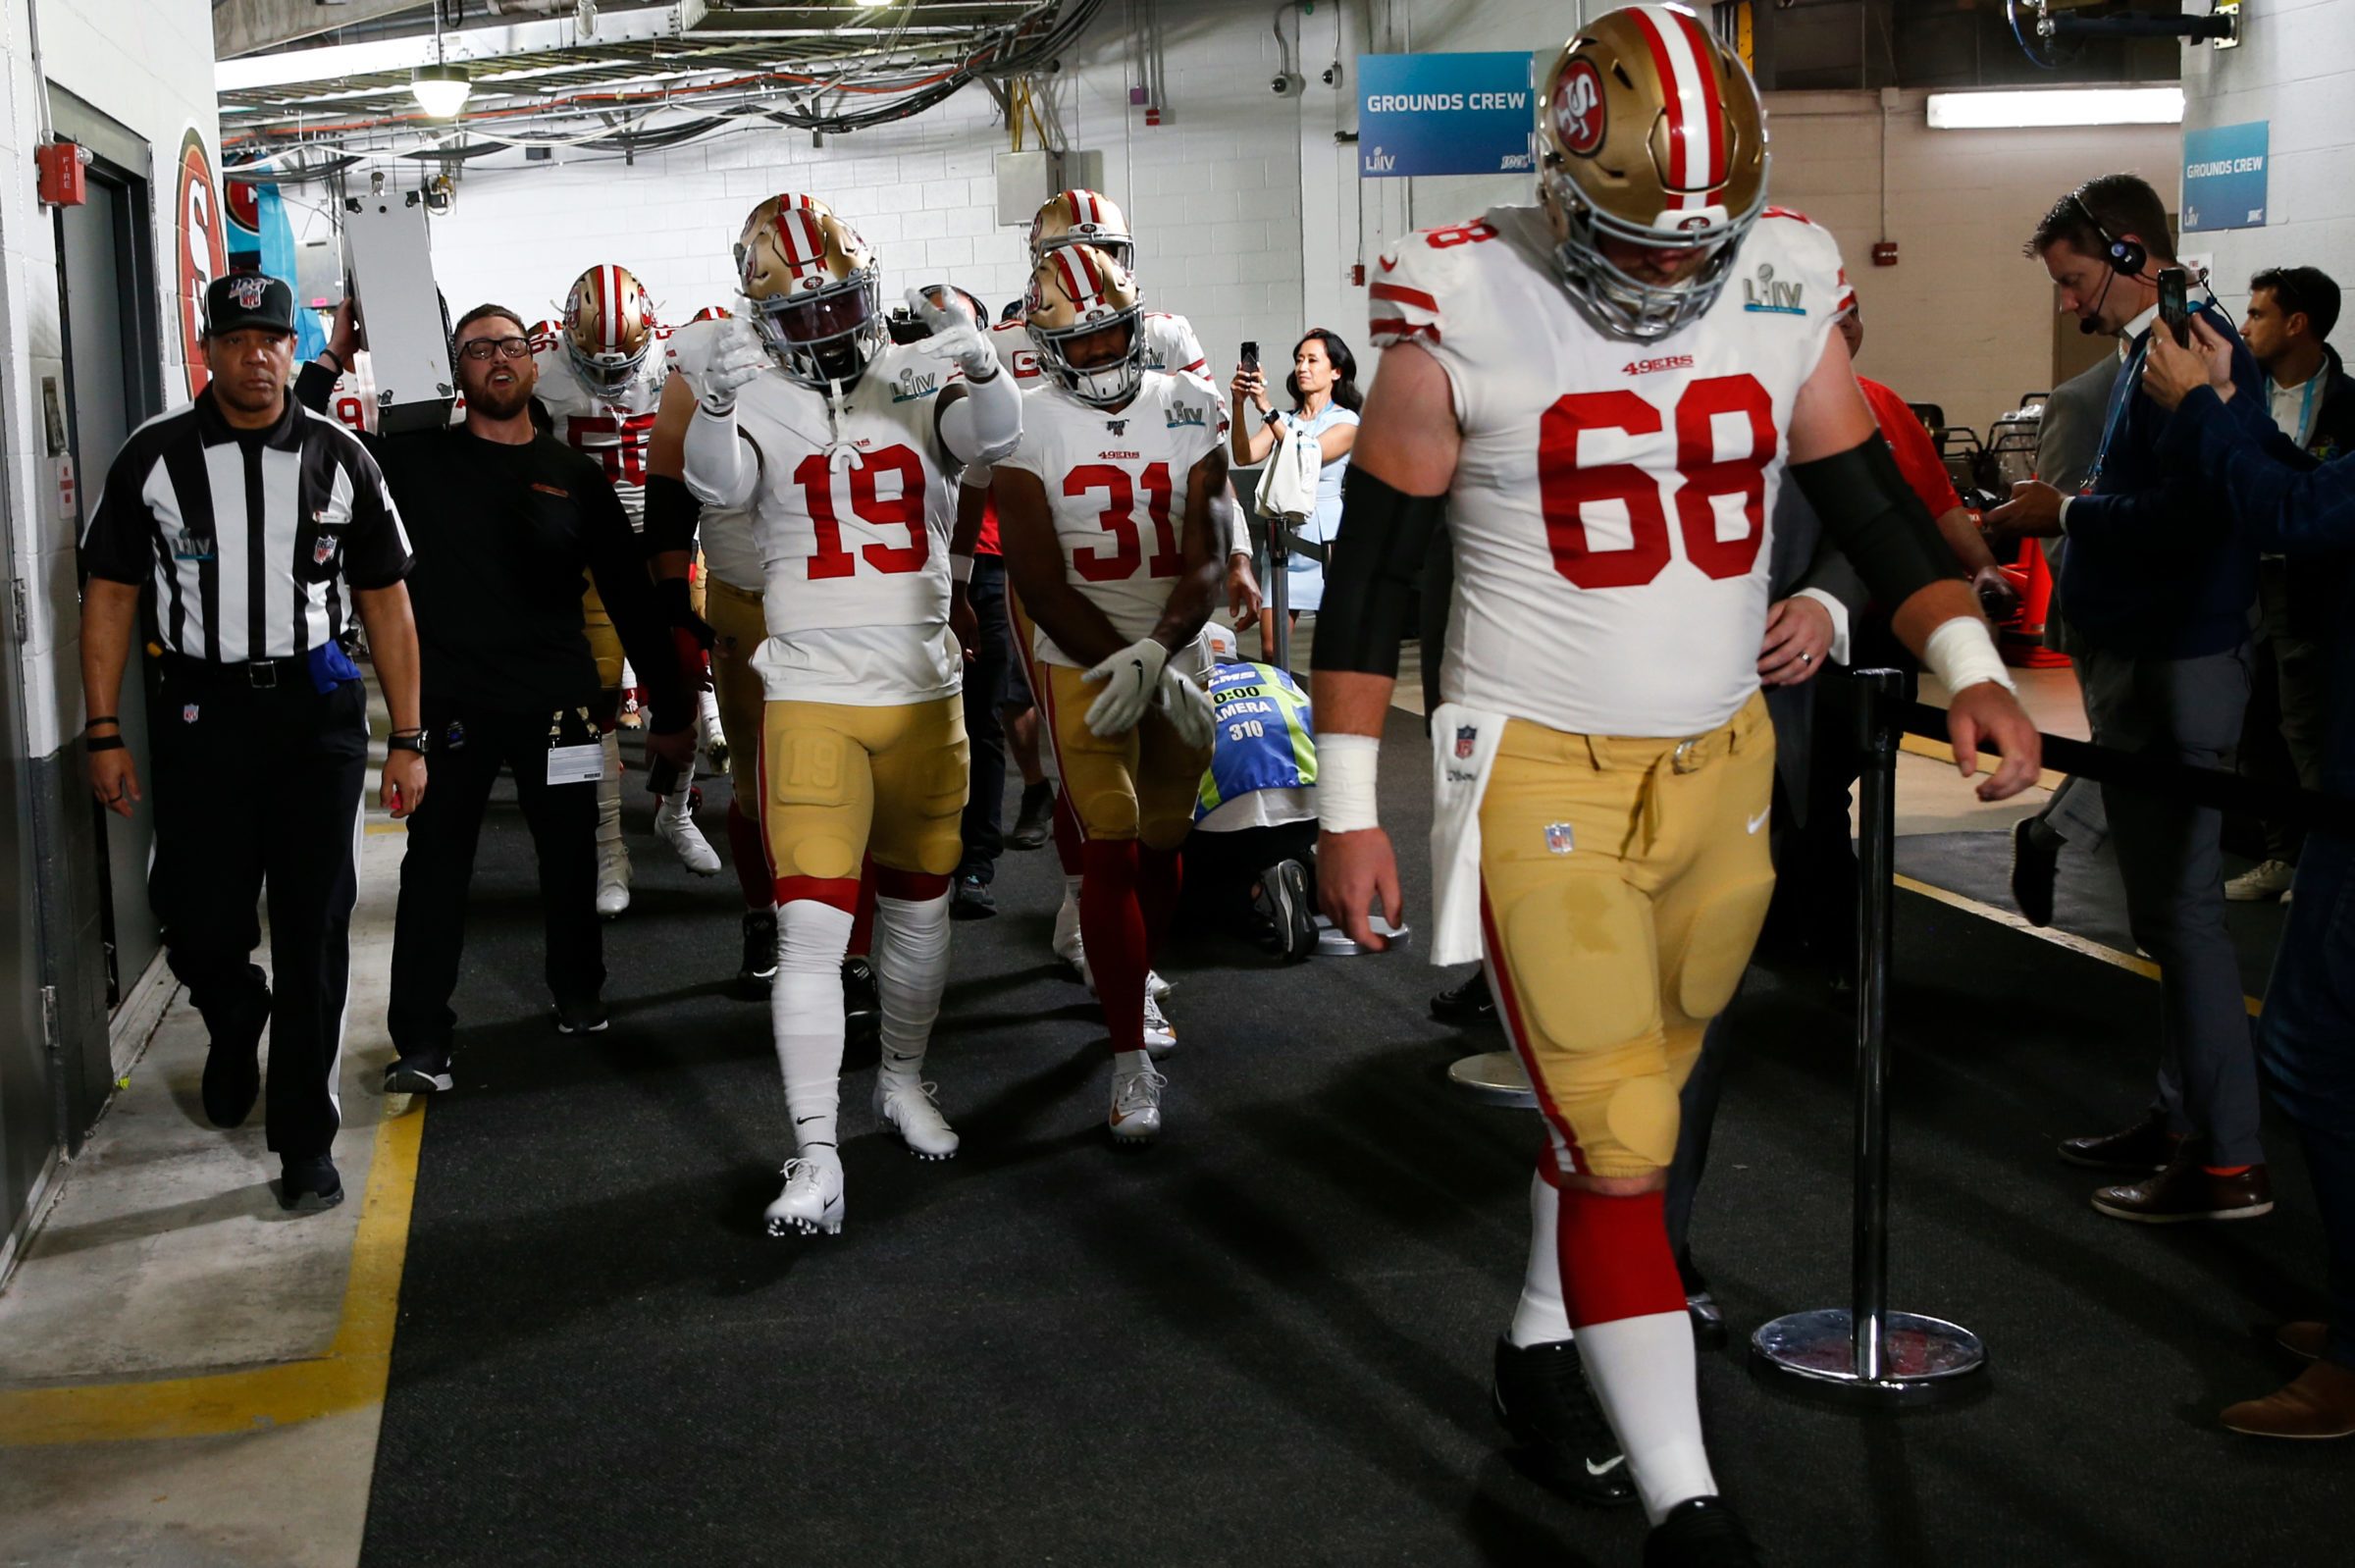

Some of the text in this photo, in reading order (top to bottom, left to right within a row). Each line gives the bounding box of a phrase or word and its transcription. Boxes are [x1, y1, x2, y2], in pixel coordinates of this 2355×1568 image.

[1367, 92, 1526, 113] GROUNDS CREW
[63, 156, 72, 189] FIRE
[2186, 156, 2264, 179] GROUNDS CREW
[1622, 354, 1695, 376] 49ERS
[1098, 450, 1140, 459] 49ERS
[1538, 373, 1778, 590] 68
[793, 444, 929, 580] 19
[1063, 462, 1185, 582] 31
[1213, 686, 1260, 705] 0:00
[1215, 701, 1273, 724] AMERA
[1229, 719, 1264, 741] 310
